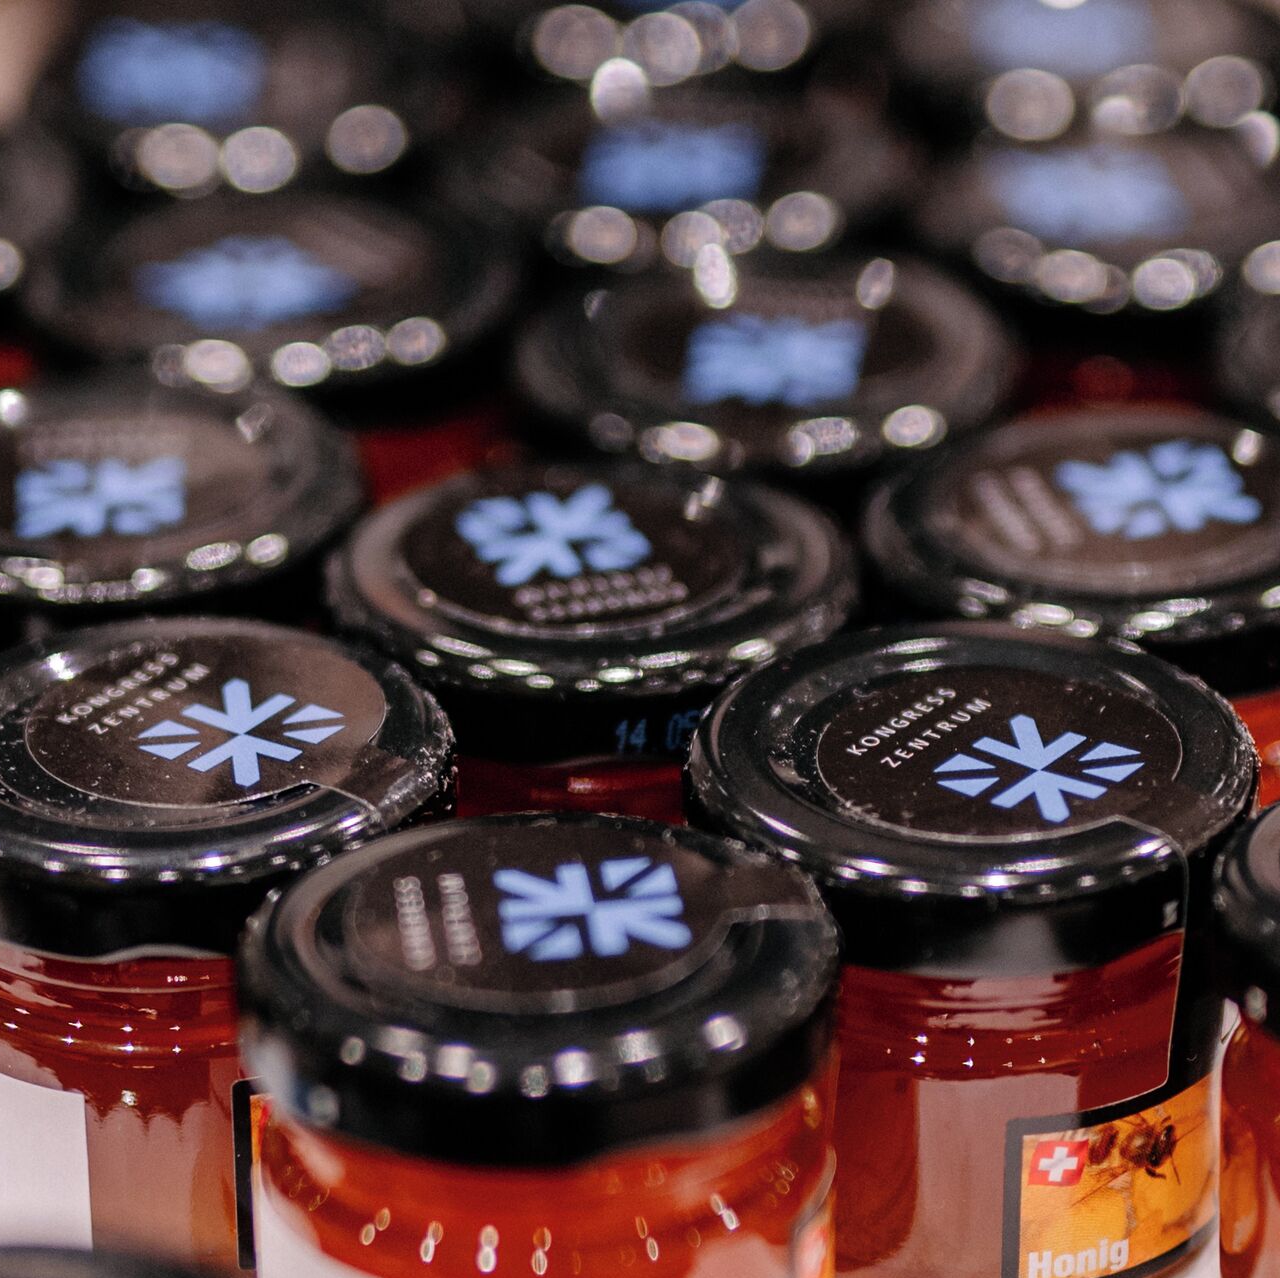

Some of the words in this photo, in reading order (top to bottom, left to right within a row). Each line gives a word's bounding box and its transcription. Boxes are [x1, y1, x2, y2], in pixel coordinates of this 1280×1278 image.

[55, 652, 179, 725] KONGRESS
[87, 663, 210, 735] ZENTRUM
[846, 687, 956, 756] KONGRESS
[880, 697, 992, 768] ZENTRUM
